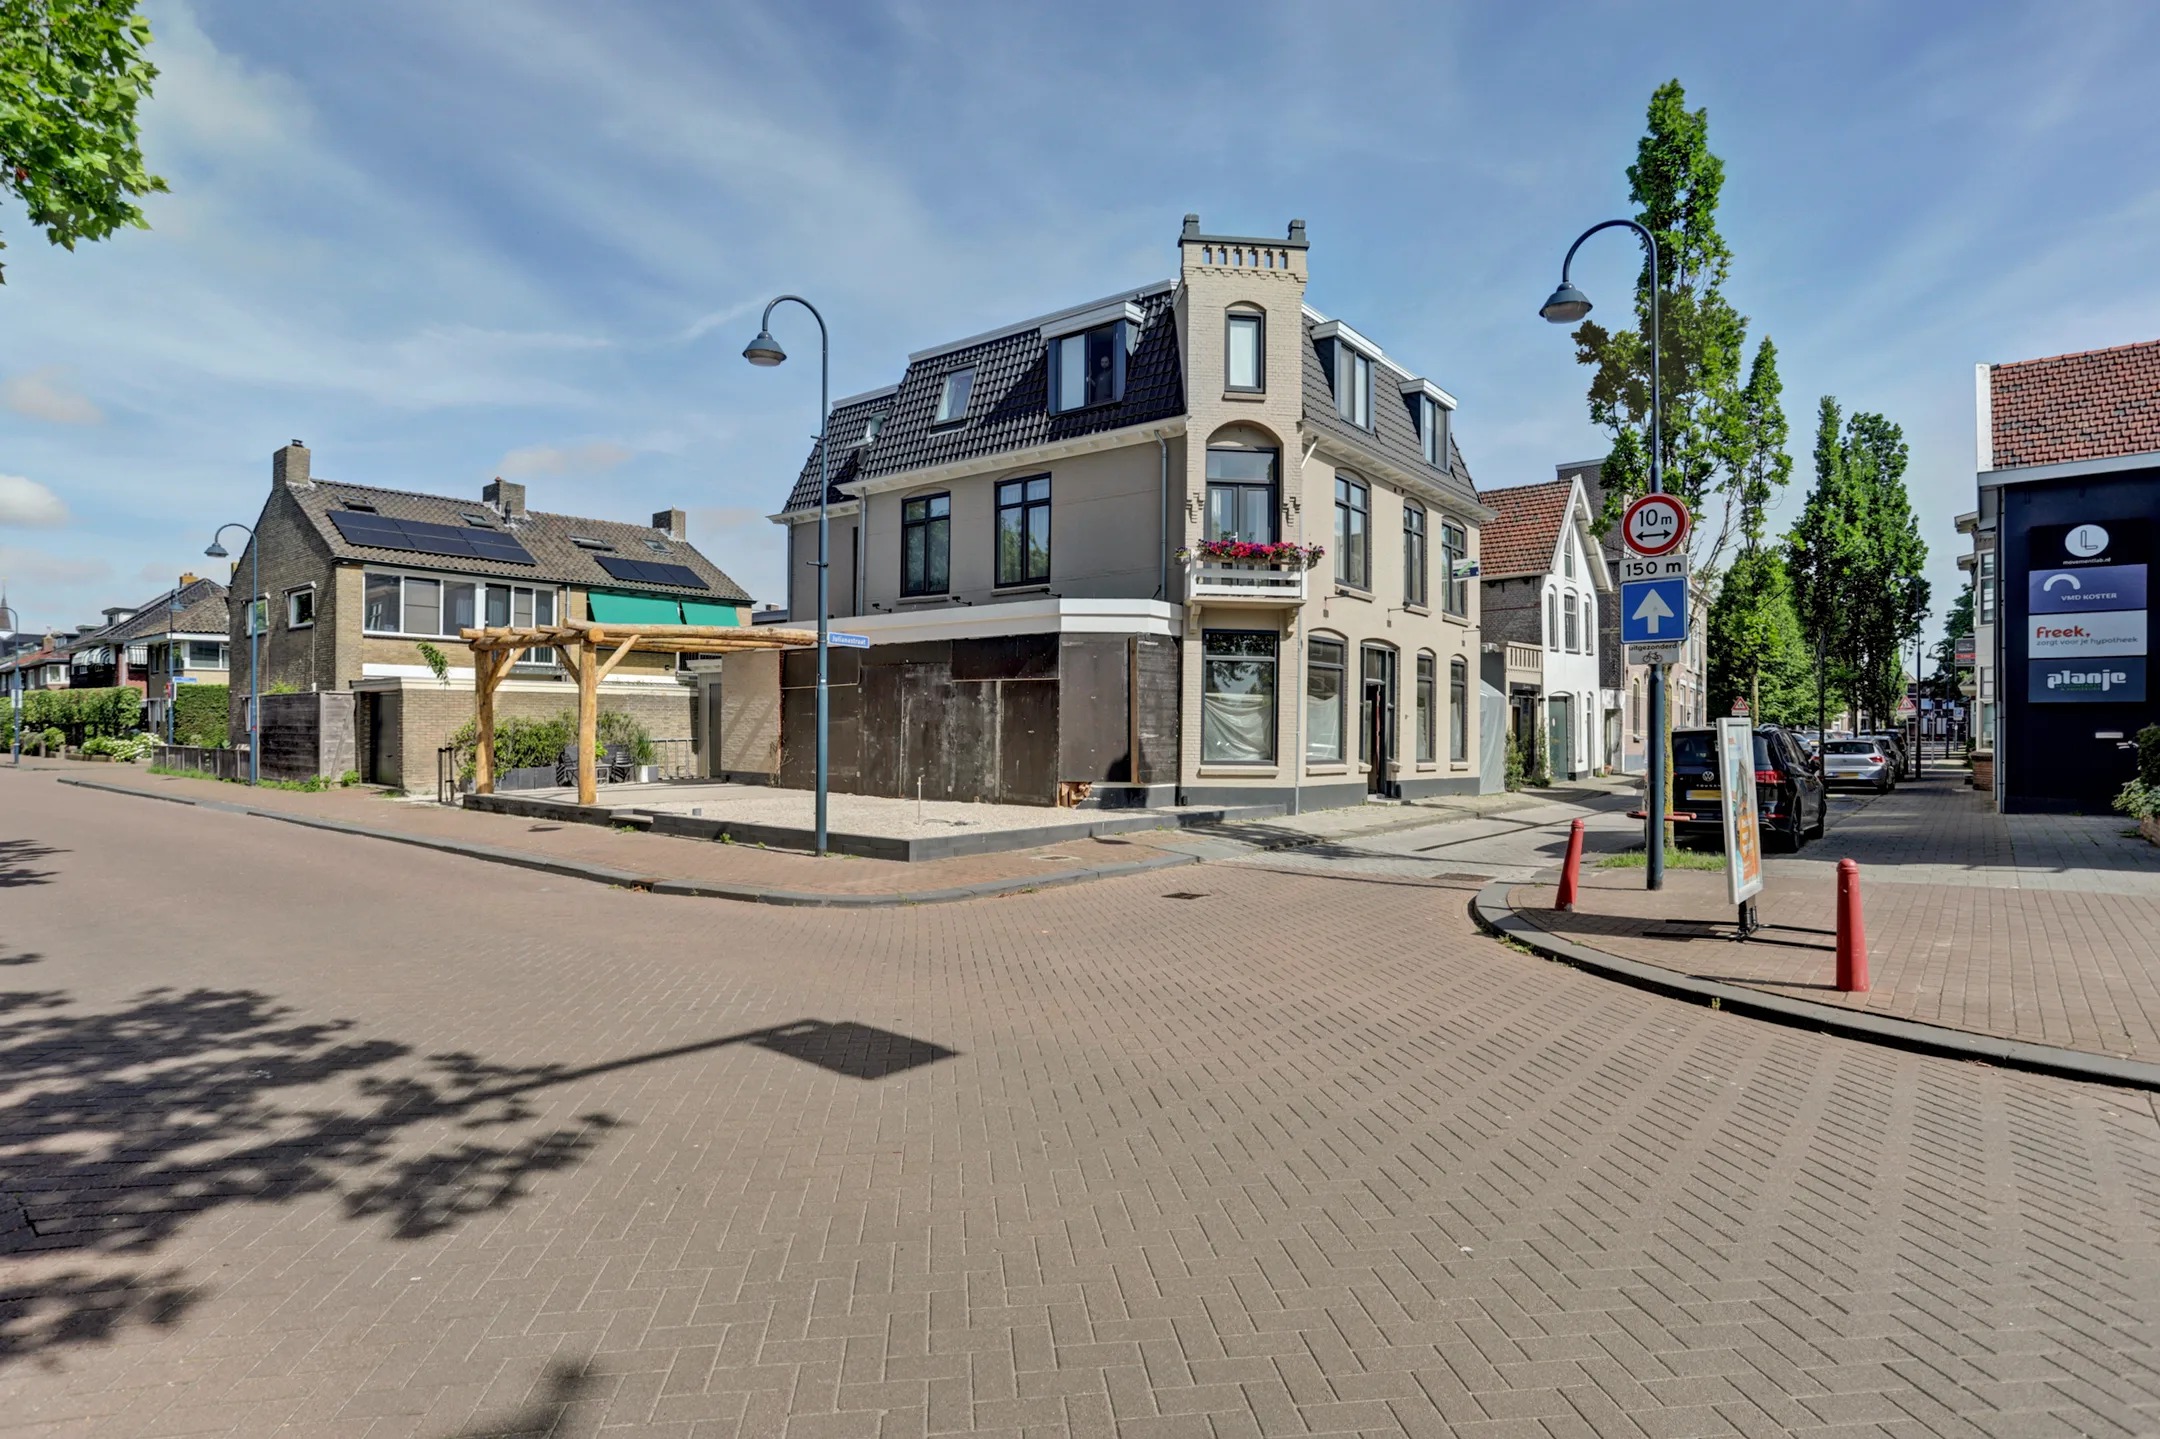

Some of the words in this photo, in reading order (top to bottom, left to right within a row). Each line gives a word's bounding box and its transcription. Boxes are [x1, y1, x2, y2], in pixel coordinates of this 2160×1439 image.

[1639, 509, 1658, 526] 10
[1661, 516, 1672, 525] m
[2063, 557, 2111, 565] movementlab.nl
[1626, 562, 1657, 577] 150
[1666, 561, 1681, 573] m
[2083, 592, 2117, 600] KOSTER
[832, 636, 866, 645] Julianastraat
[2090, 636, 2138, 645] hypotheek
[1629, 643, 1678, 651] uitgezonderd
[2047, 669, 2126, 691] planje
